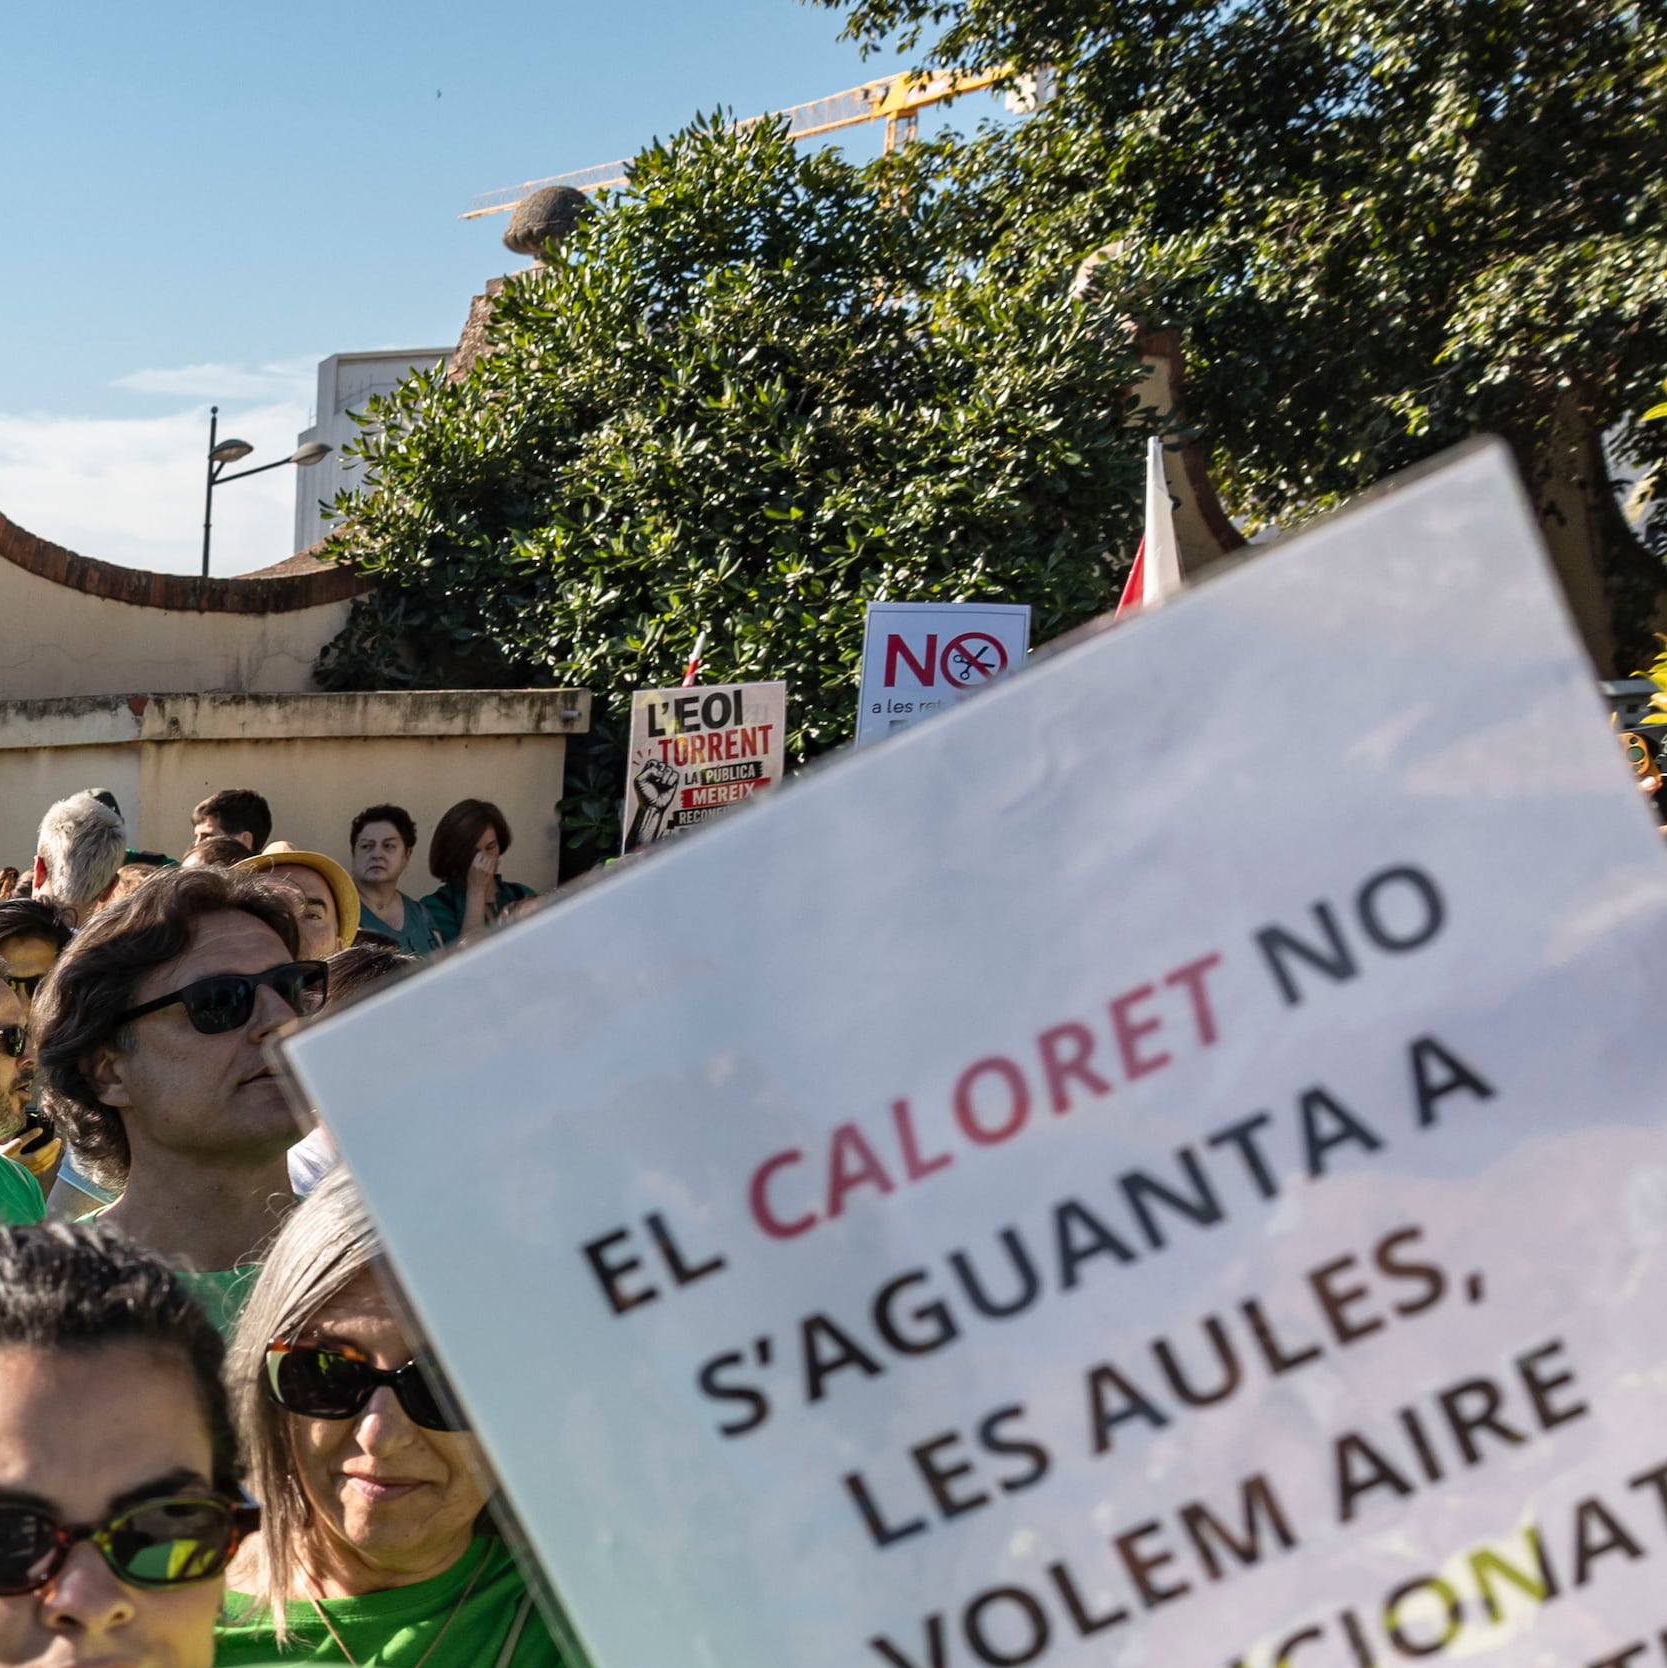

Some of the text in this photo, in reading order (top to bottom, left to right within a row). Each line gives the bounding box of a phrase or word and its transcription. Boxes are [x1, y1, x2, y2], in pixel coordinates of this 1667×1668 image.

[648, 689, 743, 738] L'EOI
[887, 699, 914, 713] les
[658, 724, 773, 767] TORRENT
[684, 765, 756, 786] LA PÚBLICA
[692, 782, 755, 806] MEREIX
[578, 862, 1448, 1315] EL CALORET NO
[696, 1033, 1498, 1440] S'AGUANTA A
[840, 1225, 1485, 1552] LES AULES,
[1330, 1339, 1591, 1526] AIRE
